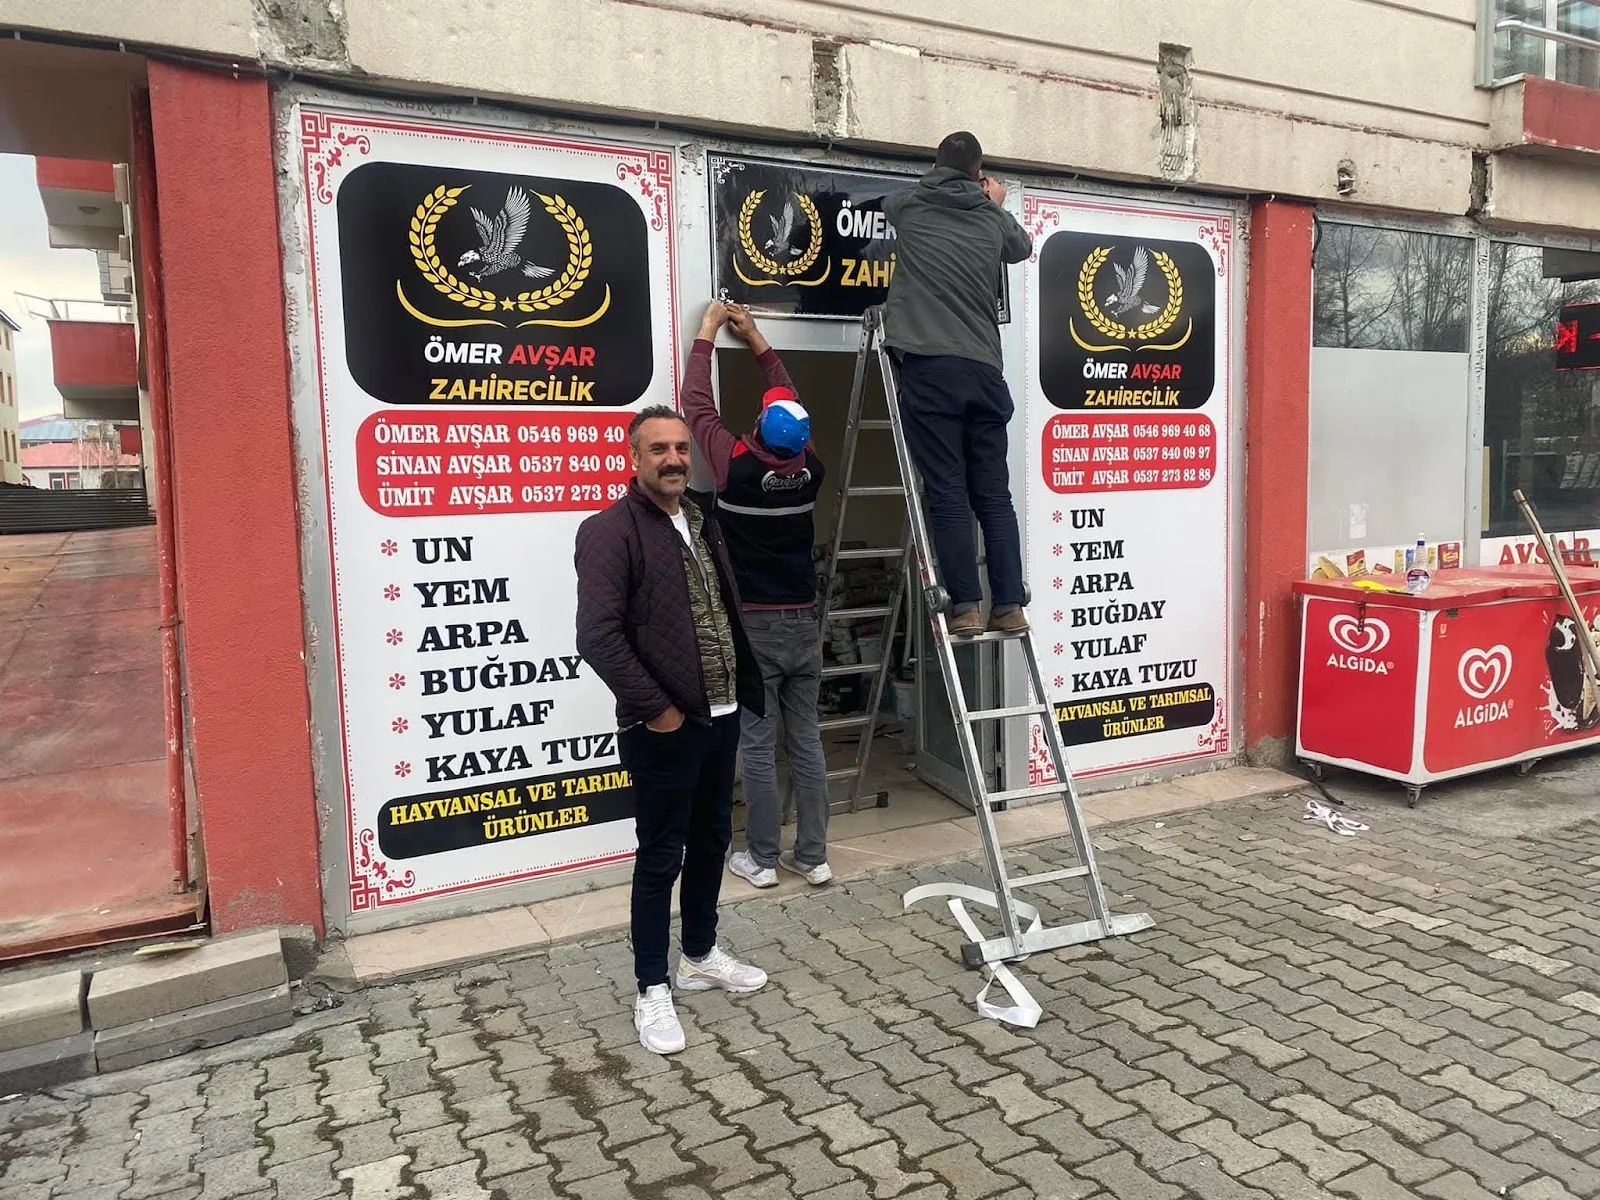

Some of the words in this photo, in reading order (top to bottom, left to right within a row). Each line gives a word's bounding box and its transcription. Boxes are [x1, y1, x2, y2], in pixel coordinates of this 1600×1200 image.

[424, 336, 502, 364] ÖMER
[508, 344, 595, 369] AVŞAR
[1083, 358, 1128, 380] ÖMER
[1131, 363, 1181, 383] AVŞAR
[429, 374, 594, 401] ZAHİRECİLİK
[1084, 384, 1180, 406] ZAHİRECİLİK
[374, 419, 439, 444] ÖMER
[445, 424, 509, 448] AVŞAR
[518, 425, 561, 443] 0546
[566, 425, 598, 443] 969
[603, 425, 624, 442] 40
[1052, 420, 1089, 439] ÖMER
[1092, 424, 1129, 442] AVŞAR
[1133, 425, 1158, 437] 0546
[1162, 424, 1180, 437] 969
[1183, 424, 1195, 437] 40
[1198, 424, 1210, 437] 68
[376, 451, 441, 476] SİNAN
[447, 455, 511, 479] AVŞAR
[519, 456, 563, 474] 0537
[568, 456, 601, 473] 840
[605, 455, 625, 472] 09
[1052, 444, 1089, 463] SİNAN
[1092, 447, 1129, 465] AVŞAR
[1133, 447, 1159, 460] 0537
[1162, 447, 1180, 460] 840
[1183, 447, 1195, 459] 09
[1198, 447, 1210, 459] 97
[1052, 468, 1085, 486] ÜMİT
[1092, 470, 1129, 488] AVŞAR
[1133, 470, 1159, 483] 0537
[1162, 469, 1180, 482] 273
[1183, 469, 1195, 481] 82
[1199, 468, 1210, 481] 88
[377, 481, 434, 507] ÜMİT
[448, 488, 513, 510] AVŞAR
[521, 487, 566, 504] 0537
[571, 486, 602, 503] 273
[1071, 509, 1105, 529] UN
[412, 536, 473, 564] UN
[1071, 541, 1125, 562] YEM
[414, 577, 510, 608] YEM
[1070, 573, 1134, 594] ARPA
[1071, 599, 1166, 628] BUĞDAY
[417, 619, 528, 652] ARPA
[1072, 634, 1148, 659] YULAF
[420, 655, 582, 696] BUĞDAY
[1072, 667, 1134, 693] KAYA
[1139, 659, 1197, 683] TUZU
[1130, 698, 1146, 711] VE
[1150, 689, 1211, 709] TARIMSAL
[421, 699, 554, 739] YULAF
[1102, 717, 1165, 737] ÜRÜNLER
[426, 743, 532, 783] KAYA
[541, 733, 615, 765] TUZ
[390, 791, 522, 826] HAYVANSAL
[526, 782, 557, 804] VE
[561, 771, 632, 797] TARIM
[483, 806, 589, 840] ÜRÜNLER
